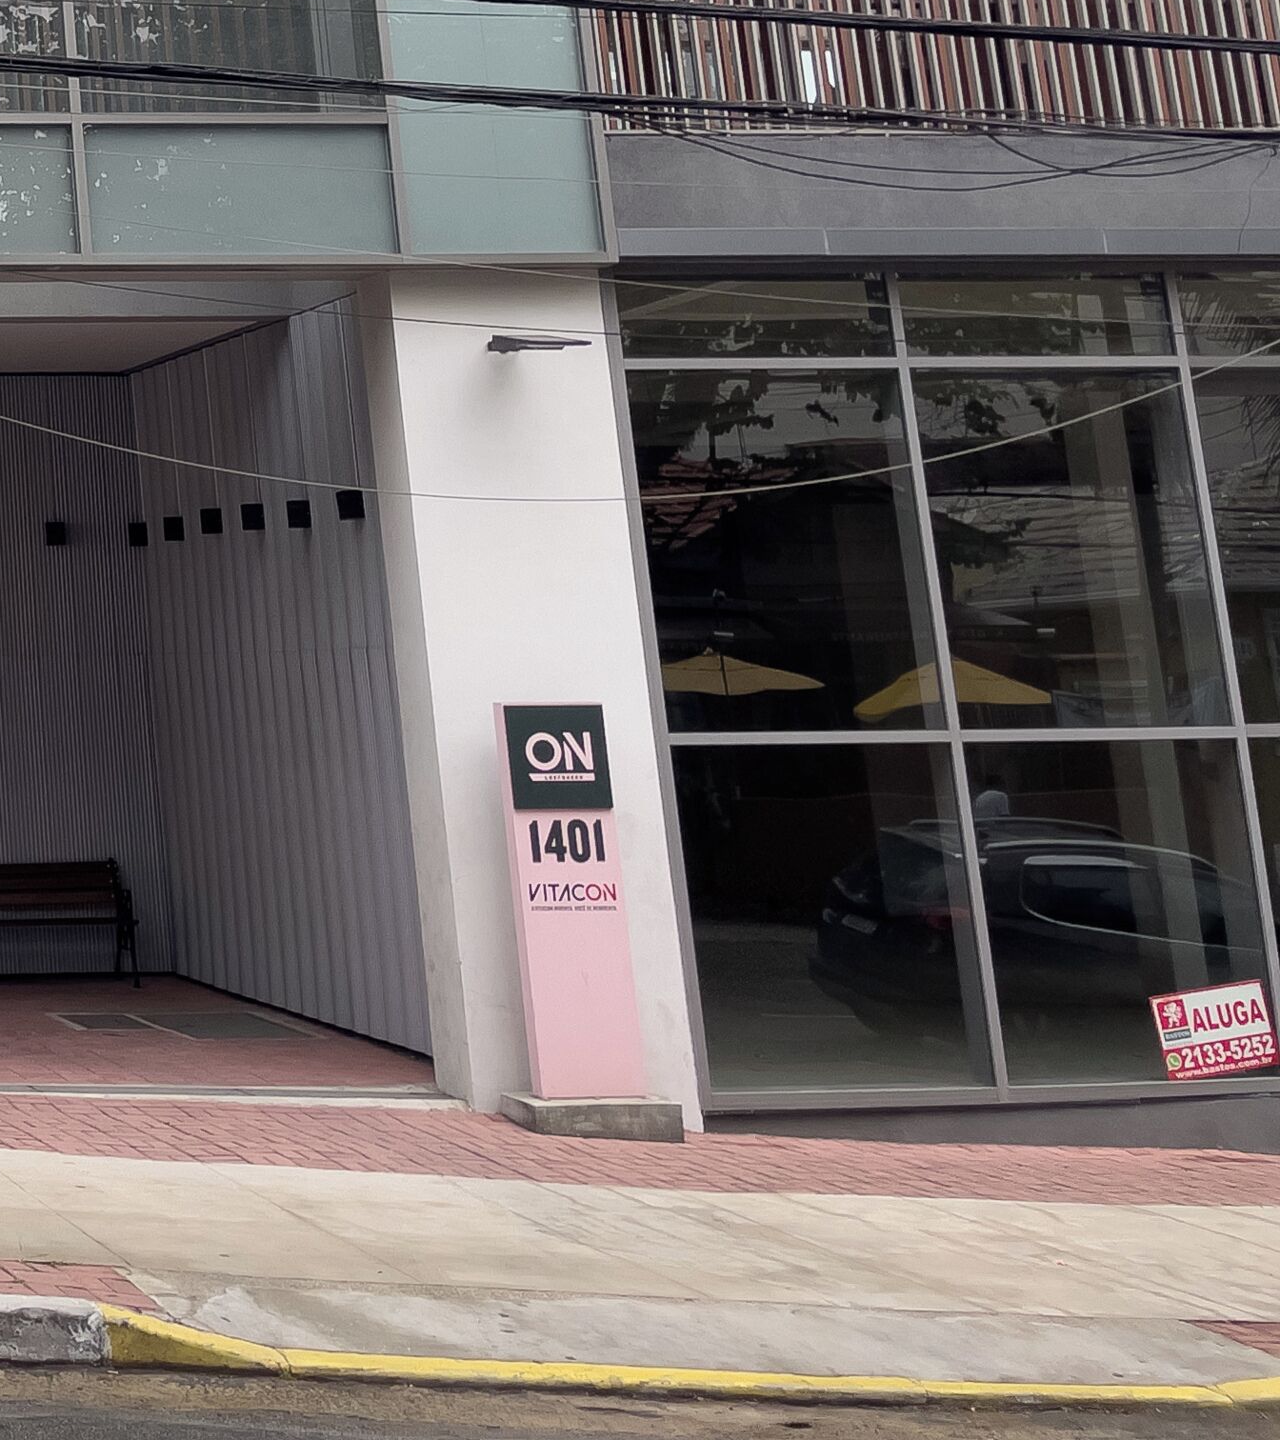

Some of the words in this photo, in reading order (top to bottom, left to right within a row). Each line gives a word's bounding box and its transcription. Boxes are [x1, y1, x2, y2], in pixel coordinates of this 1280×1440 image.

[525, 731, 595, 771] ON
[529, 818, 606, 864] 1401
[528, 883, 617, 902] VITACON
[1193, 998, 1265, 1033] ALUGA
[1175, 1057, 1273, 1079] www.bastos.com.br
[1182, 1035, 1276, 1069] 2133-5252
